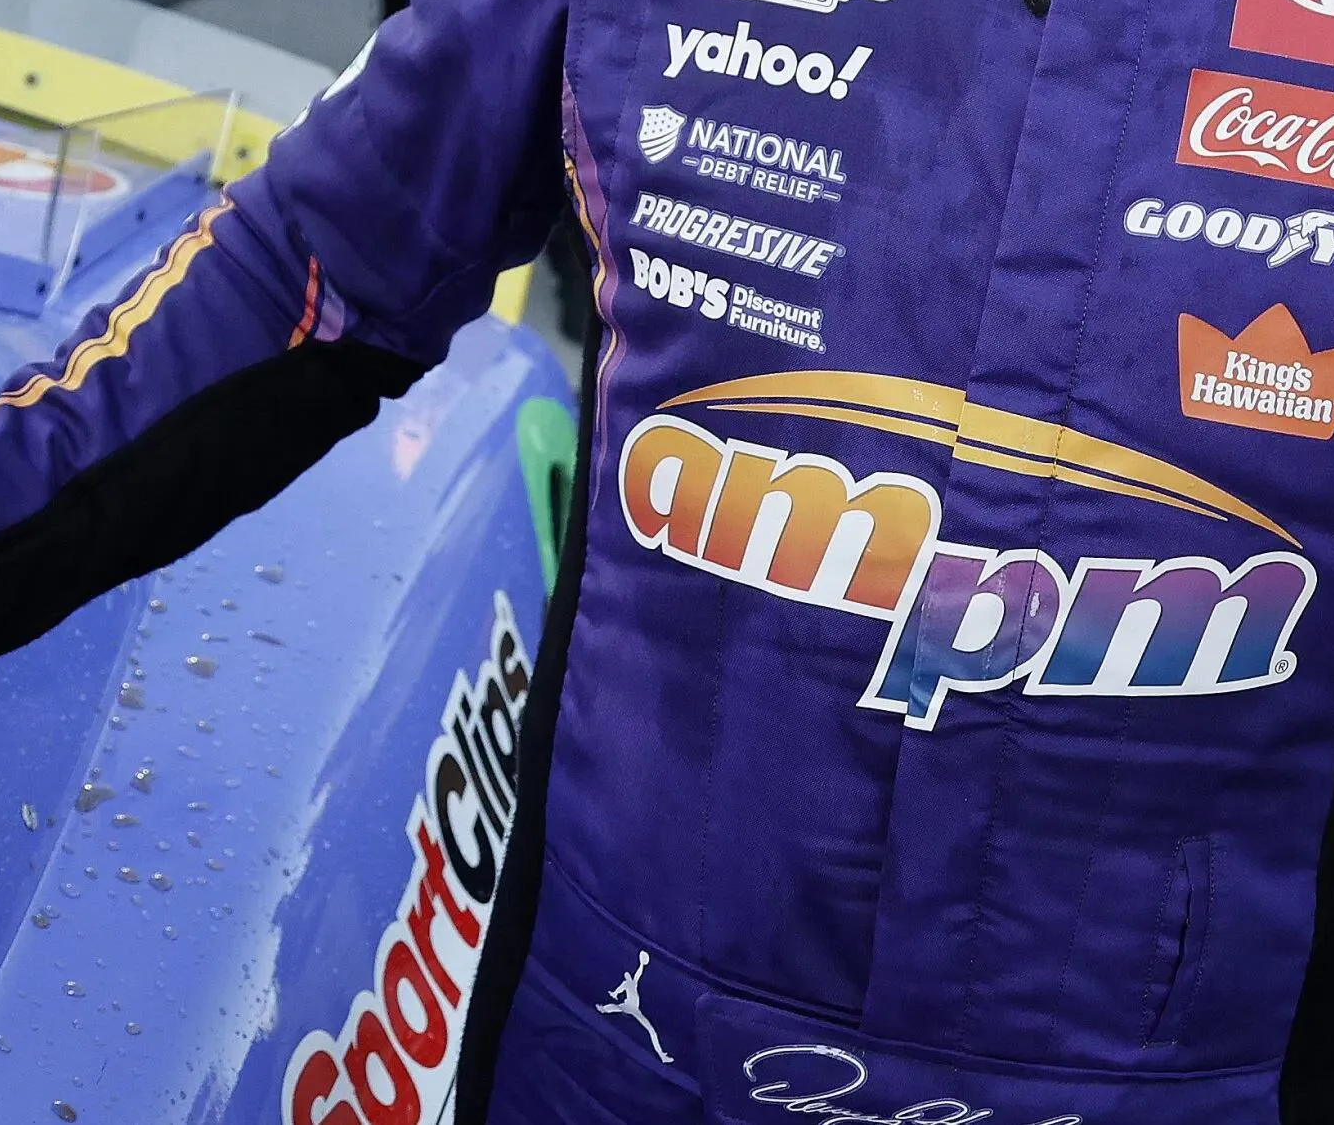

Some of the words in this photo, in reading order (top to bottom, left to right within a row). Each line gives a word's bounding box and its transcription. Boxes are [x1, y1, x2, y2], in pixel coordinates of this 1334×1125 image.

[663, 20, 874, 100] yahoo!
[687, 119, 846, 183] NATIONAL
[699, 157, 751, 185] DEBT
[752, 169, 822, 202] RELIEF
[632, 193, 838, 278] PROGRESSIVE
[629, 247, 731, 320] BOB'S
[733, 286, 821, 330] Discount
[729, 307, 825, 353] Furniture.
[1191, 372, 1333, 423] Hawaiian
[1223, 350, 1313, 392] King's
[618, 414, 1317, 732] ampm
